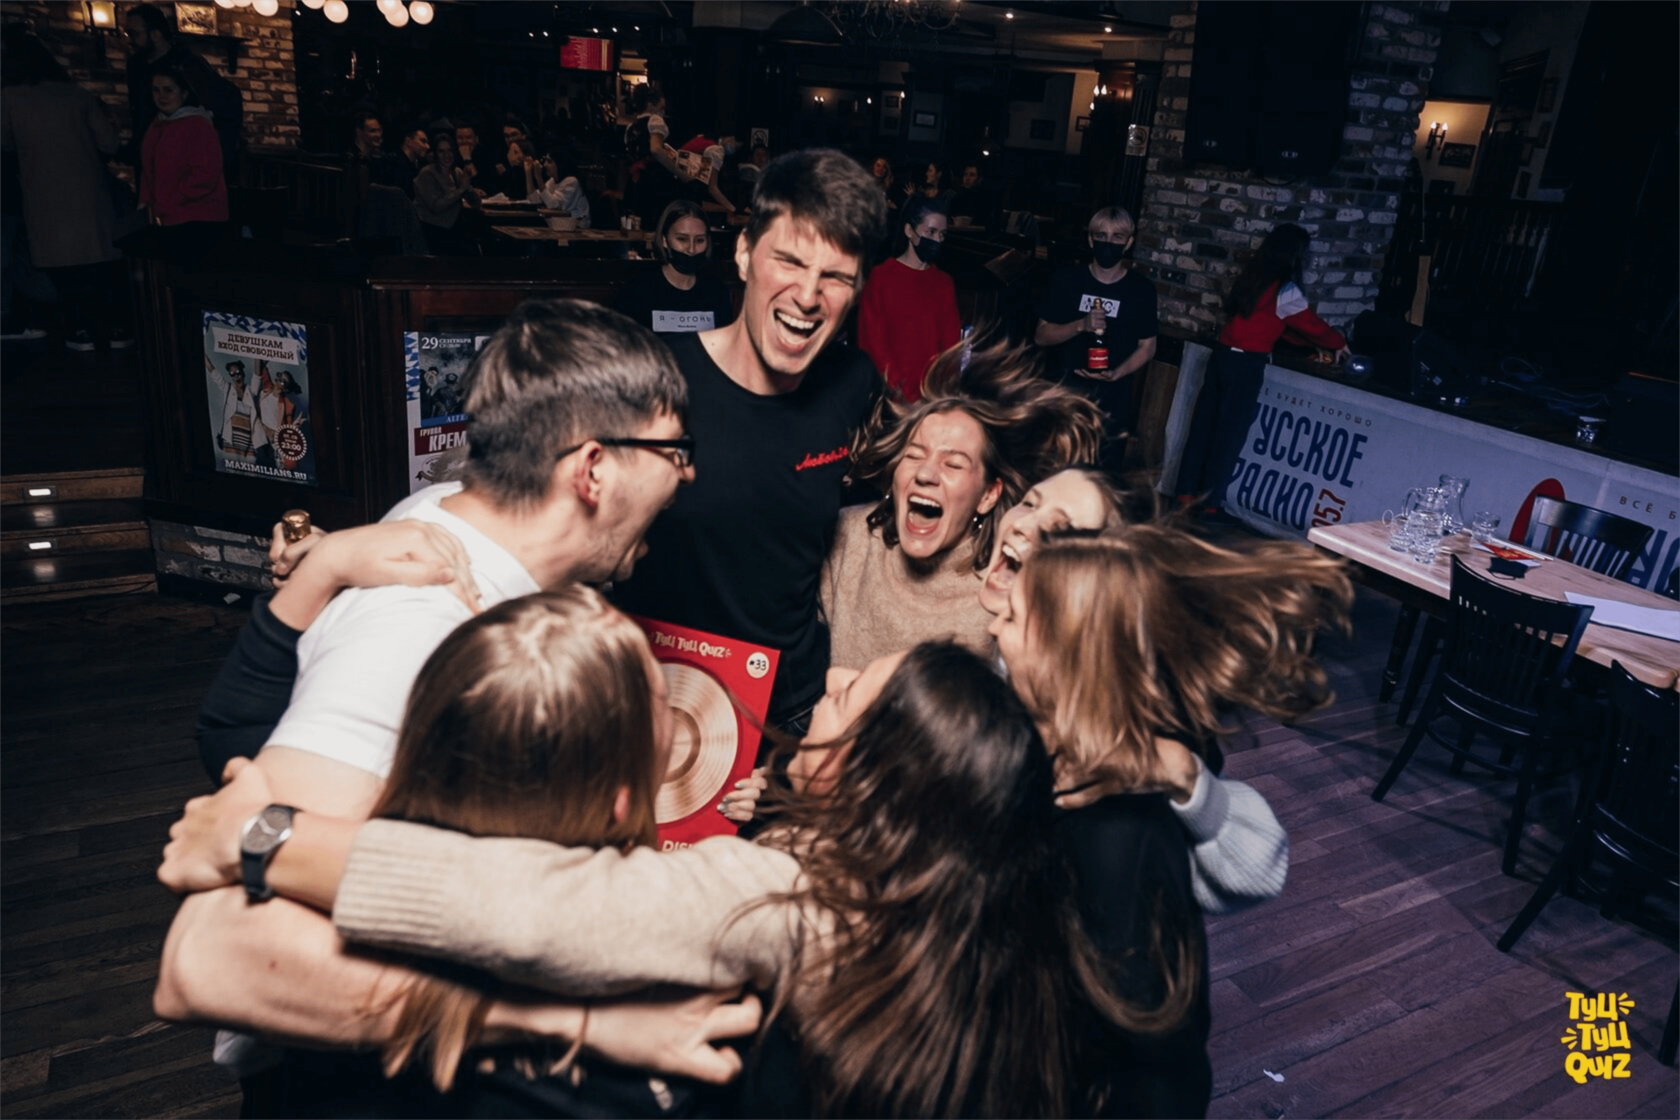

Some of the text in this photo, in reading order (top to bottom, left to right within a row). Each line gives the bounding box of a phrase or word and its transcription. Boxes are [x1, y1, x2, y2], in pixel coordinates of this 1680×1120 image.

[228, 333, 283, 349] ДЕВУШКАМ
[421, 336, 439, 349] 29
[217, 341, 294, 361] ВХОД СВОБОДНЫЙ
[1277, 392, 1372, 427] БУДЕТ ХОРОШО
[280, 441, 302, 451] 23:00
[1249, 402, 1368, 489] УССКОЕ
[224, 459, 307, 480] MAXIMILIANS.RU
[1619, 496, 1654, 513] ВСЁ
